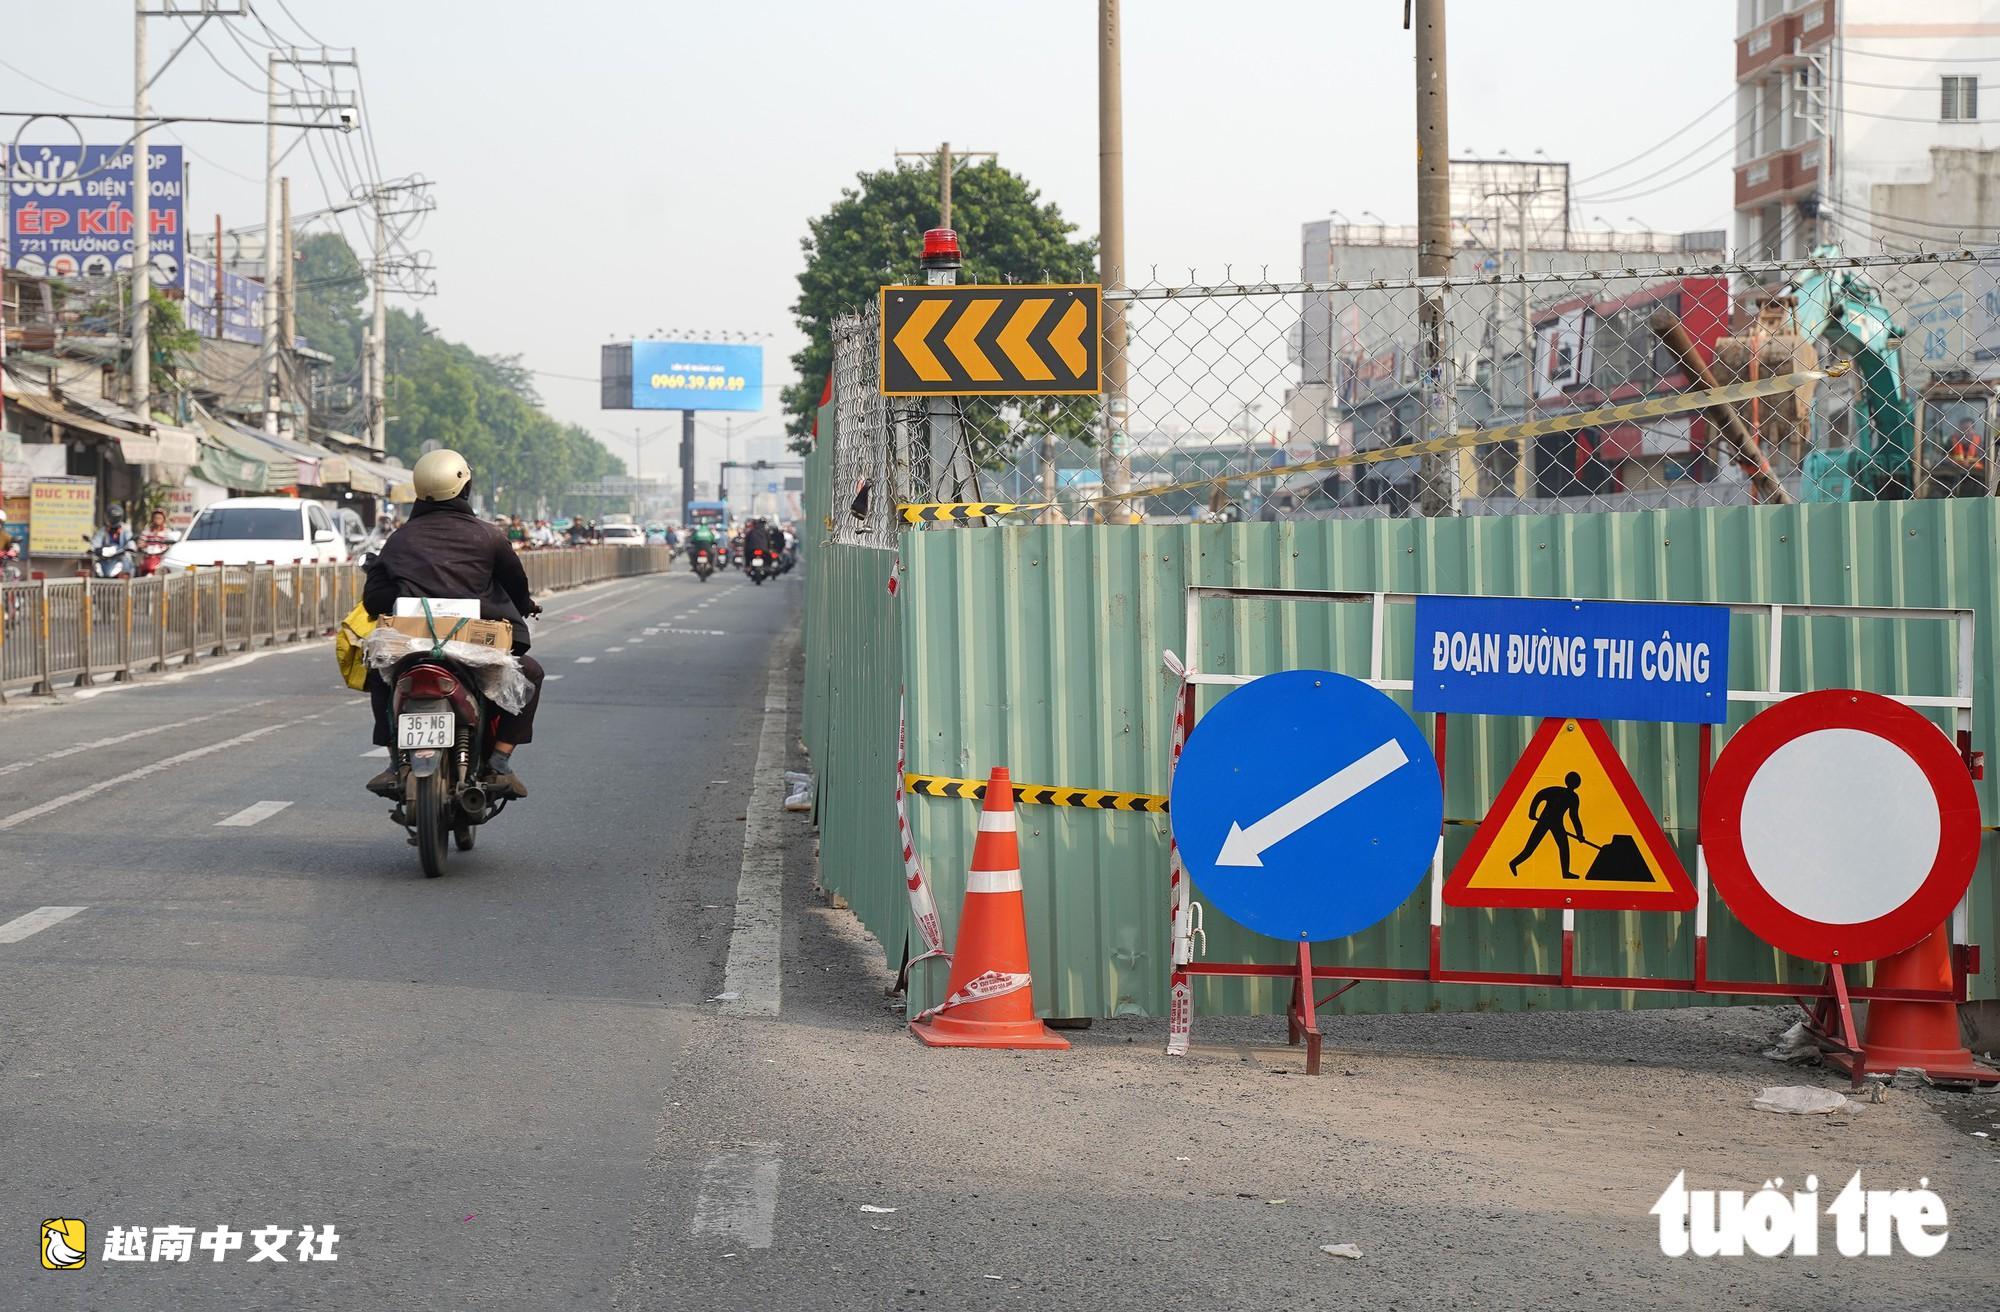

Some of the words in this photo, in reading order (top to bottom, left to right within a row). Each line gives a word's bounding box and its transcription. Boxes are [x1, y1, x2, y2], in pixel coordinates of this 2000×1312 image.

[12, 147, 83, 197] SỬA
[100, 154, 167, 170] LAPOP
[86, 177, 126, 201] ĐIỆN
[16, 201, 70, 234] ÉP
[20, 239, 47, 252] 721
[49, 236, 120, 252] TRƯỜNG
[123, 239, 174, 252] CNH
[1433, 631, 1500, 676] ĐOẠN
[1507, 628, 1586, 677] ĐƯỜNG
[1594, 638, 1634, 680] THI
[1641, 630, 1710, 684] CÔNG
[407, 716, 445, 730] 36-N6
[407, 731, 445, 746] 0748
